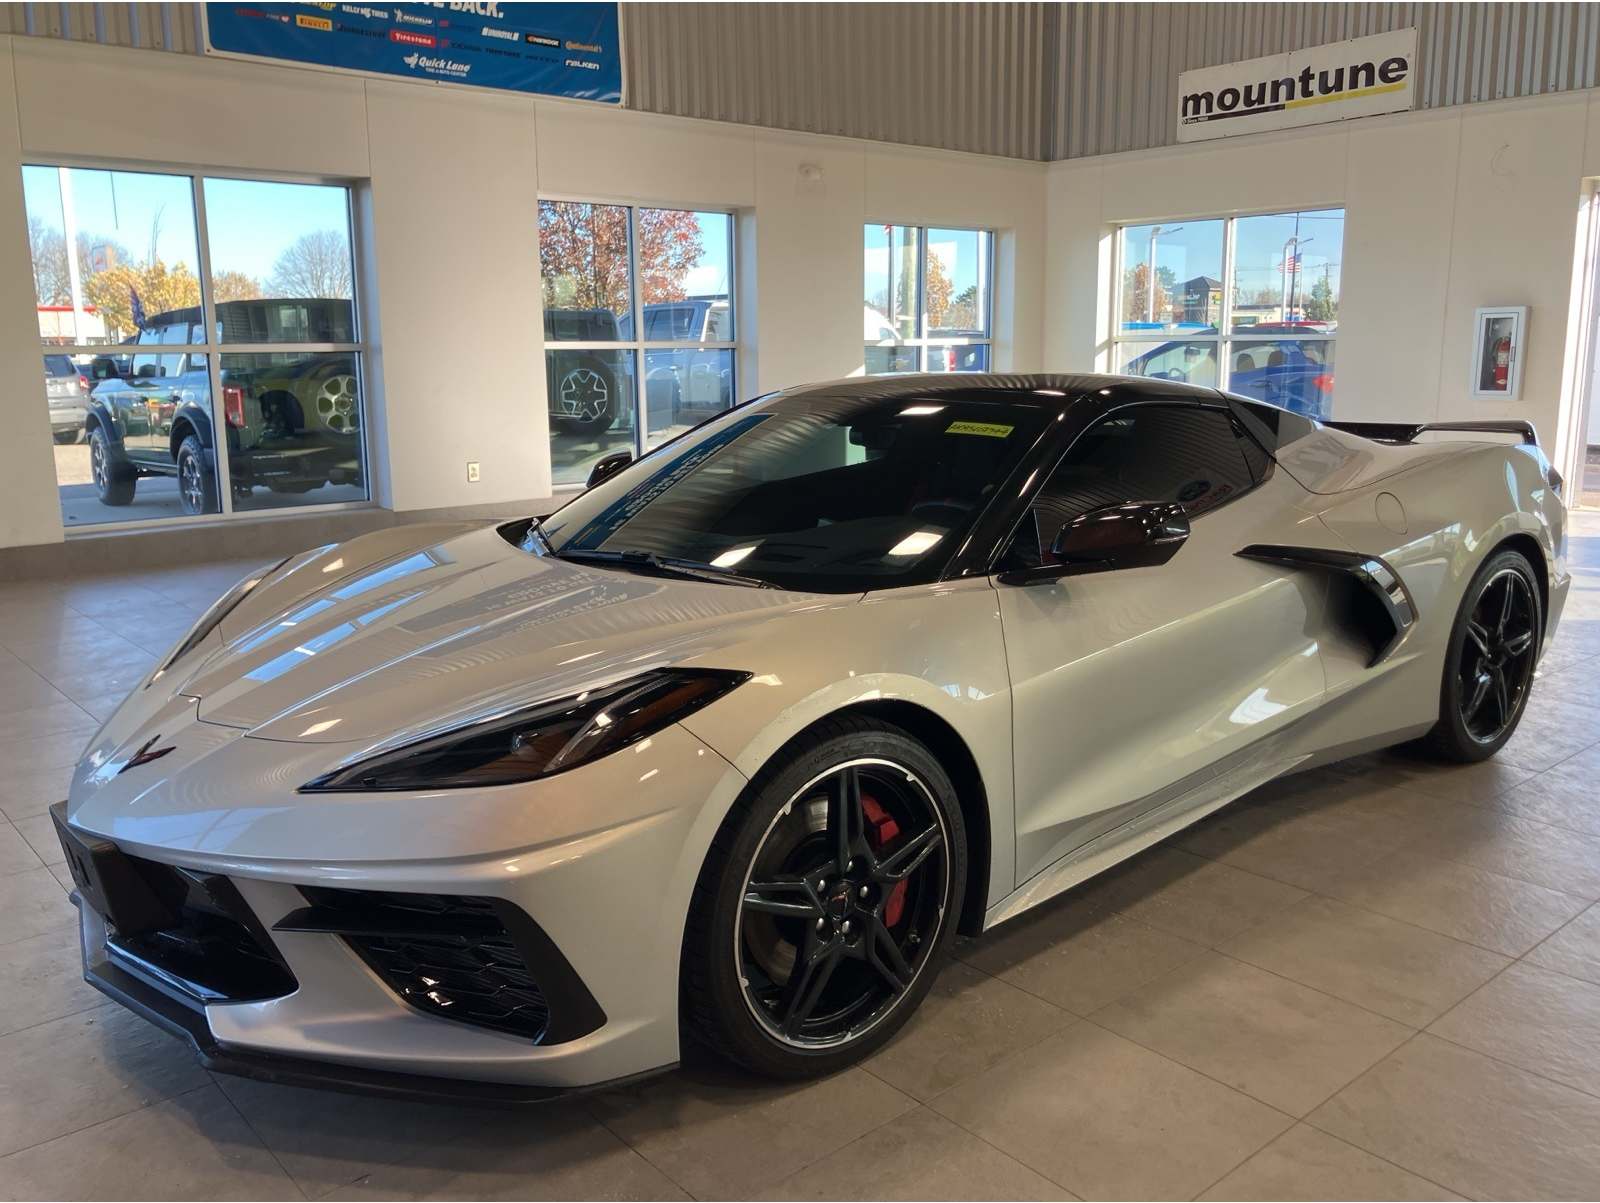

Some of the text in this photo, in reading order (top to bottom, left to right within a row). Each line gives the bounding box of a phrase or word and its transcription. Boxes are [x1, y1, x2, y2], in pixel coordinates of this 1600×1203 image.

[419, 56, 471, 72] Quick Lane
[1182, 57, 1408, 117] mountune
